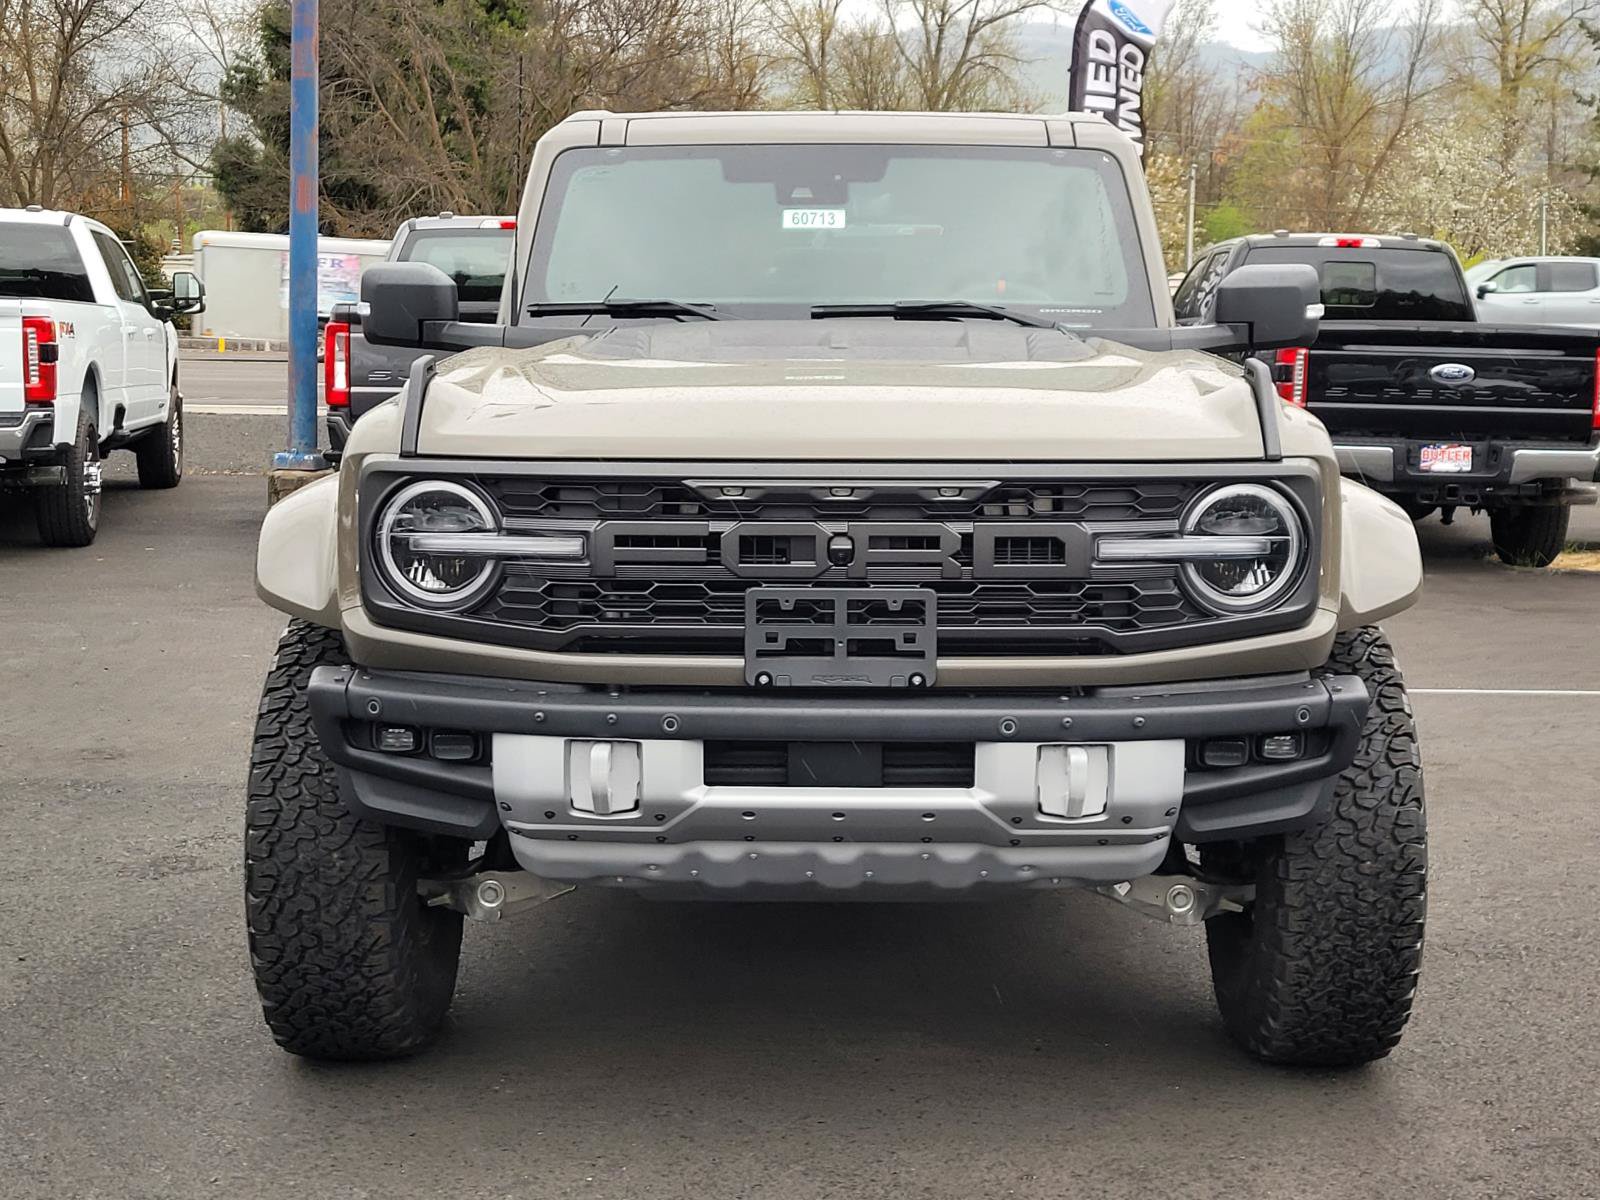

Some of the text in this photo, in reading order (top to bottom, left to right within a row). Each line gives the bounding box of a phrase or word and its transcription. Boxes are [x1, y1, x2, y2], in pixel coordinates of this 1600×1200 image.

[791, 211, 836, 226] 60713
[1421, 448, 1471, 462] BUTLER
[592, 521, 1090, 579] FORD
